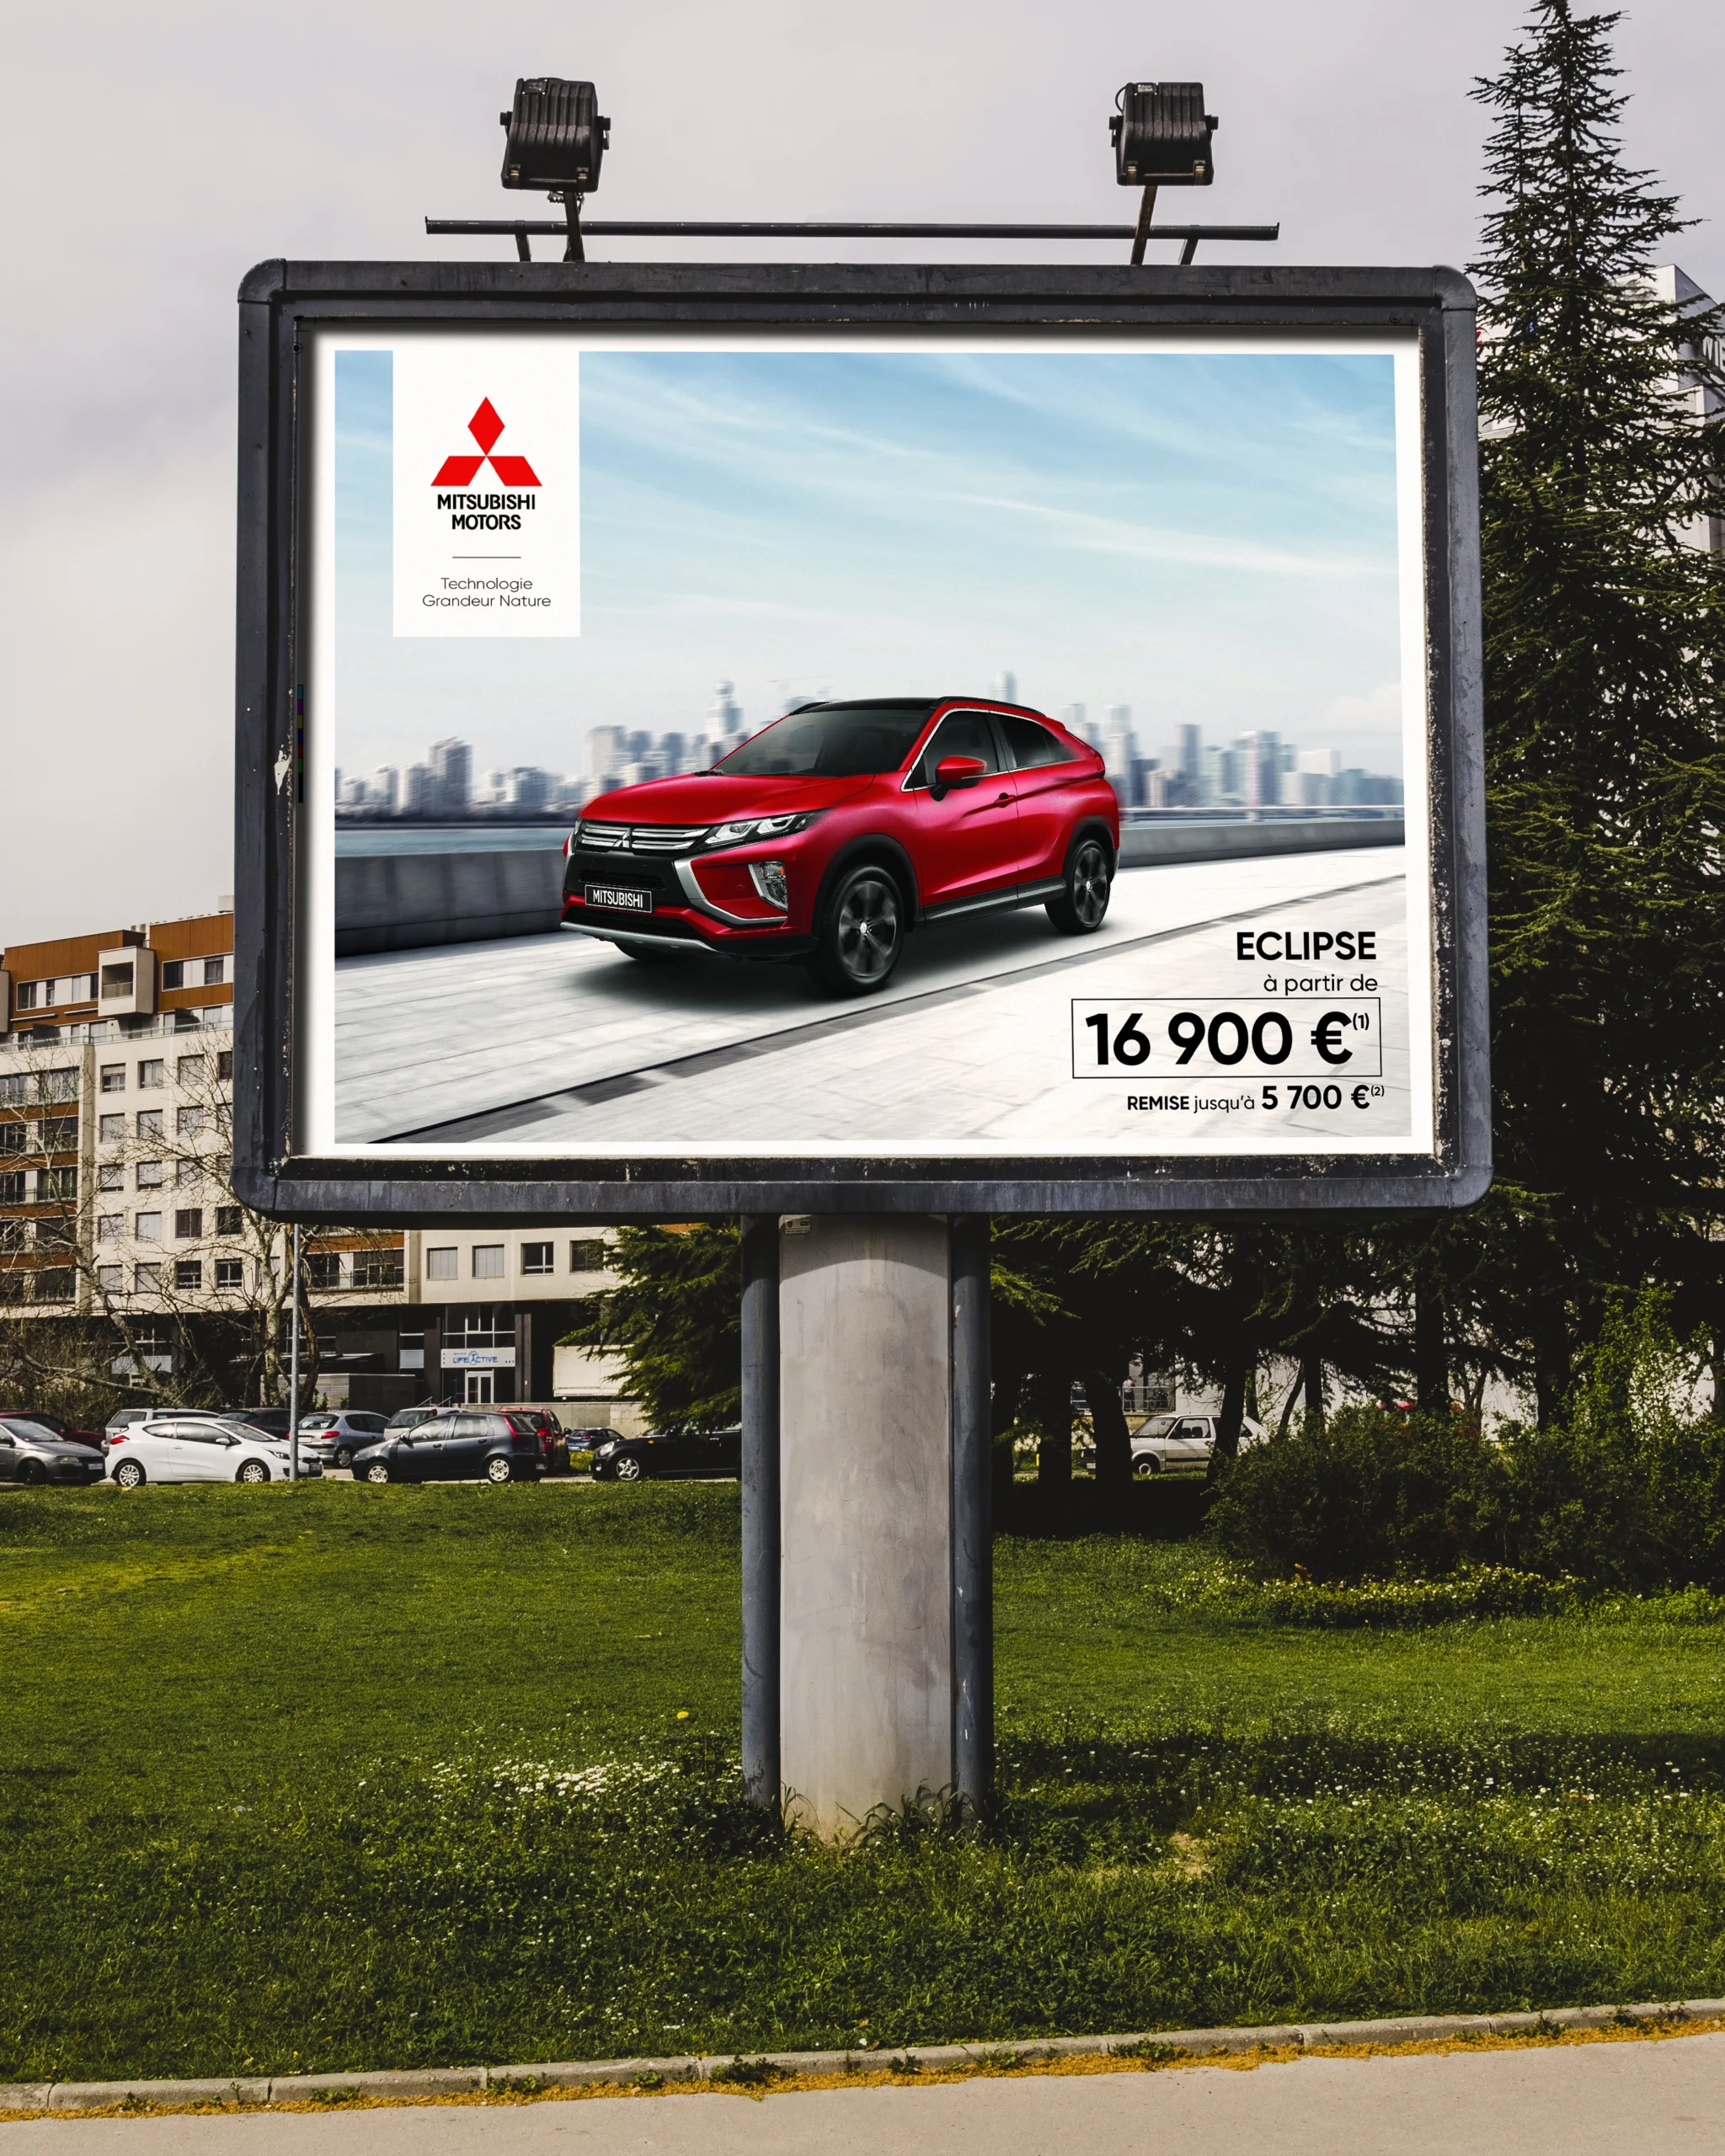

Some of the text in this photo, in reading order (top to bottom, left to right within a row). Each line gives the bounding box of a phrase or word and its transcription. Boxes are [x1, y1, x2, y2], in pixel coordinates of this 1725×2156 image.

[437, 494, 536, 510] MITSUBISHI
[451, 514, 521, 531] MOTORS
[441, 577, 533, 593] Technologie
[422, 594, 552, 607] Grandeur Nature
[592, 889, 644, 908] MITSUBISHI
[1236, 931, 1377, 961] ECLIPSE
[1263, 973, 1378, 996] à partir de
[1085, 1012, 1151, 1066] 16
[1167, 1011, 1293, 1065] 900
[1127, 1095, 1190, 1111] REMISE
[1194, 1095, 1255, 1114] jusqu'à
[1261, 1085, 1279, 1110] 5
[1286, 1084, 1343, 1110] 700
